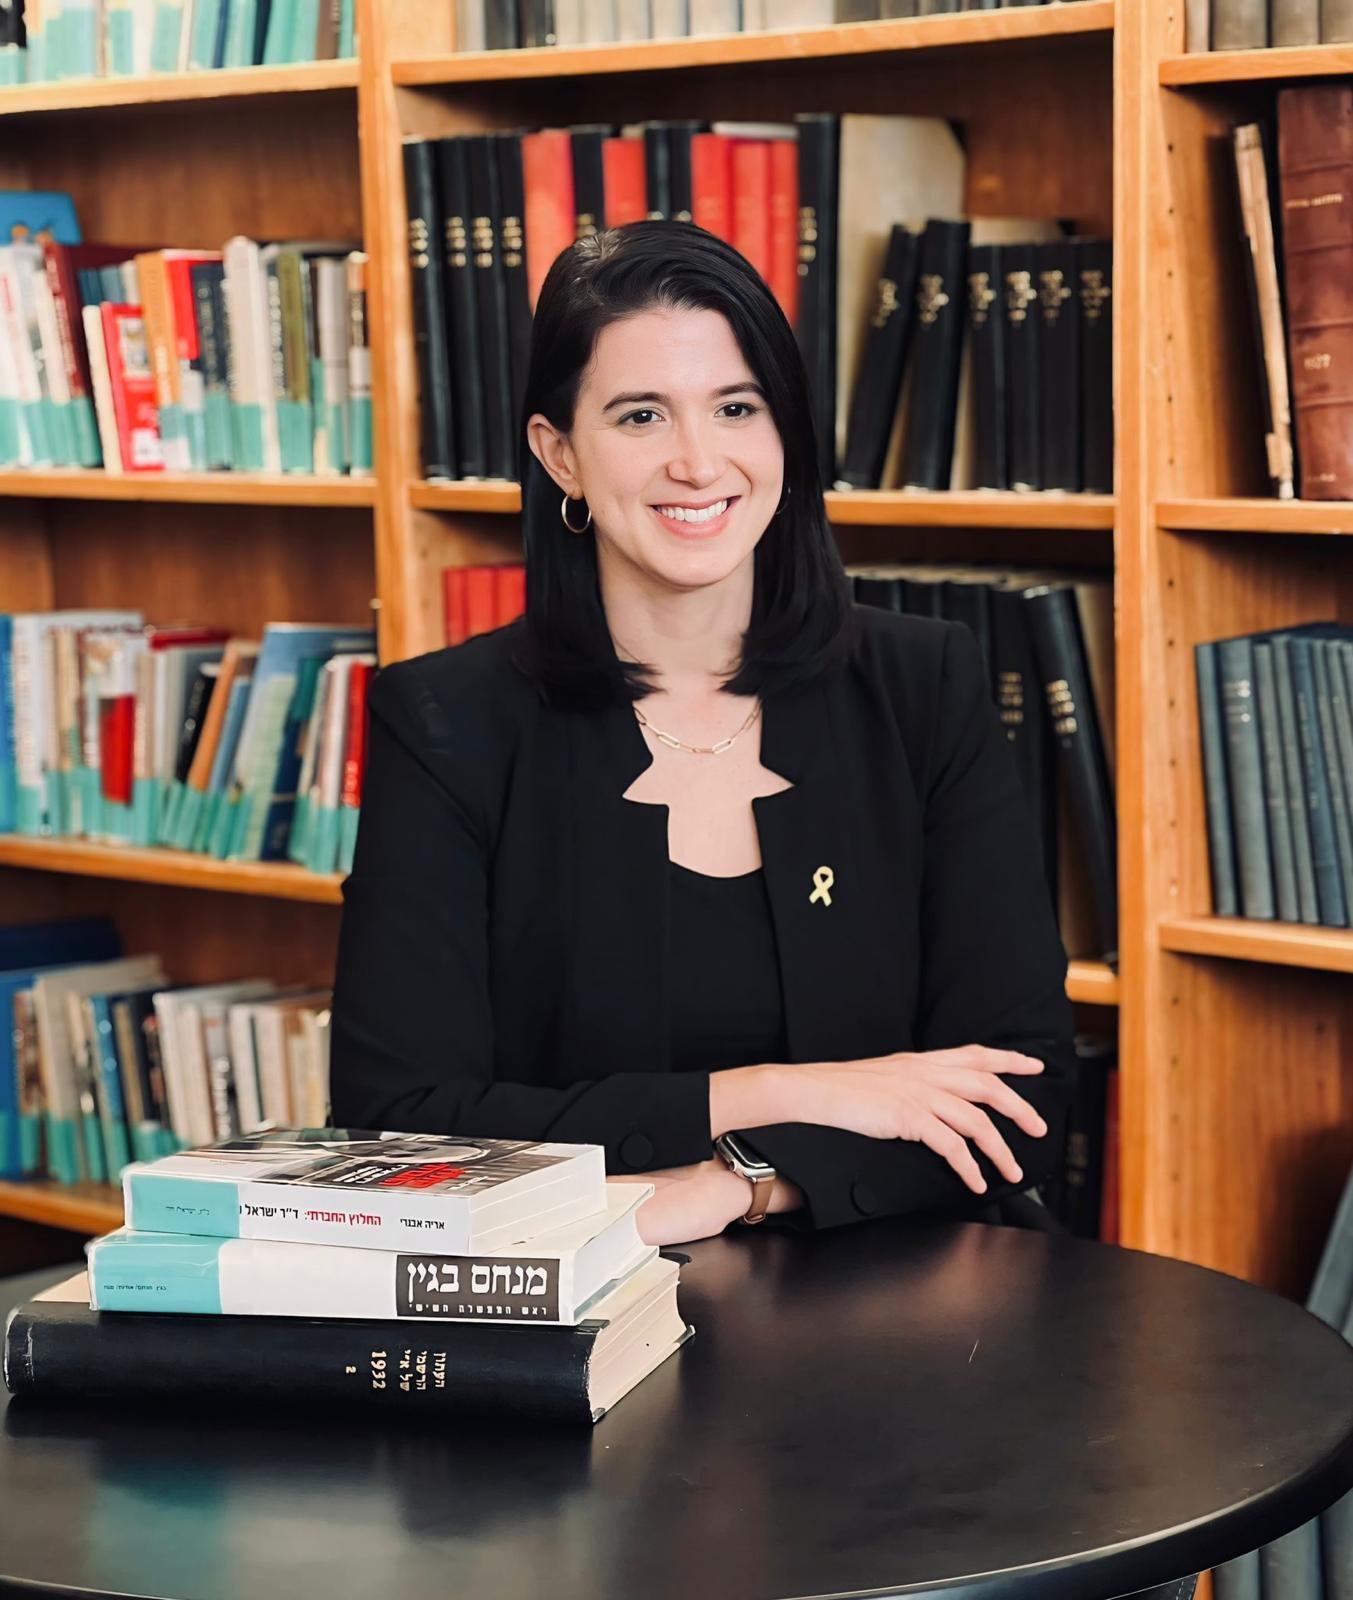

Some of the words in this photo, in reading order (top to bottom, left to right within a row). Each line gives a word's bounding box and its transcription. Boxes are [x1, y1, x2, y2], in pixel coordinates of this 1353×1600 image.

[244, 1203, 277, 1217] ישראל
[304, 1210, 346, 1223] החברתי:
[348, 1213, 382, 1226] החלוץ
[399, 1218, 423, 1228] אבנרי
[424, 1220, 445, 1230] אריה
[407, 1262, 460, 1303] בגין
[471, 1264, 548, 1296] מנחם
[409, 1303, 449, 1313] השישי
[458, 1303, 512, 1314] הממשלה
[521, 1305, 547, 1316] ראש
[345, 1365, 357, 1374] 2
[370, 1350, 387, 1389] 1932
[416, 1350, 428, 1390] הרשמי
[432, 1352, 446, 1388] העתון
[399, 1373, 413, 1392] של
